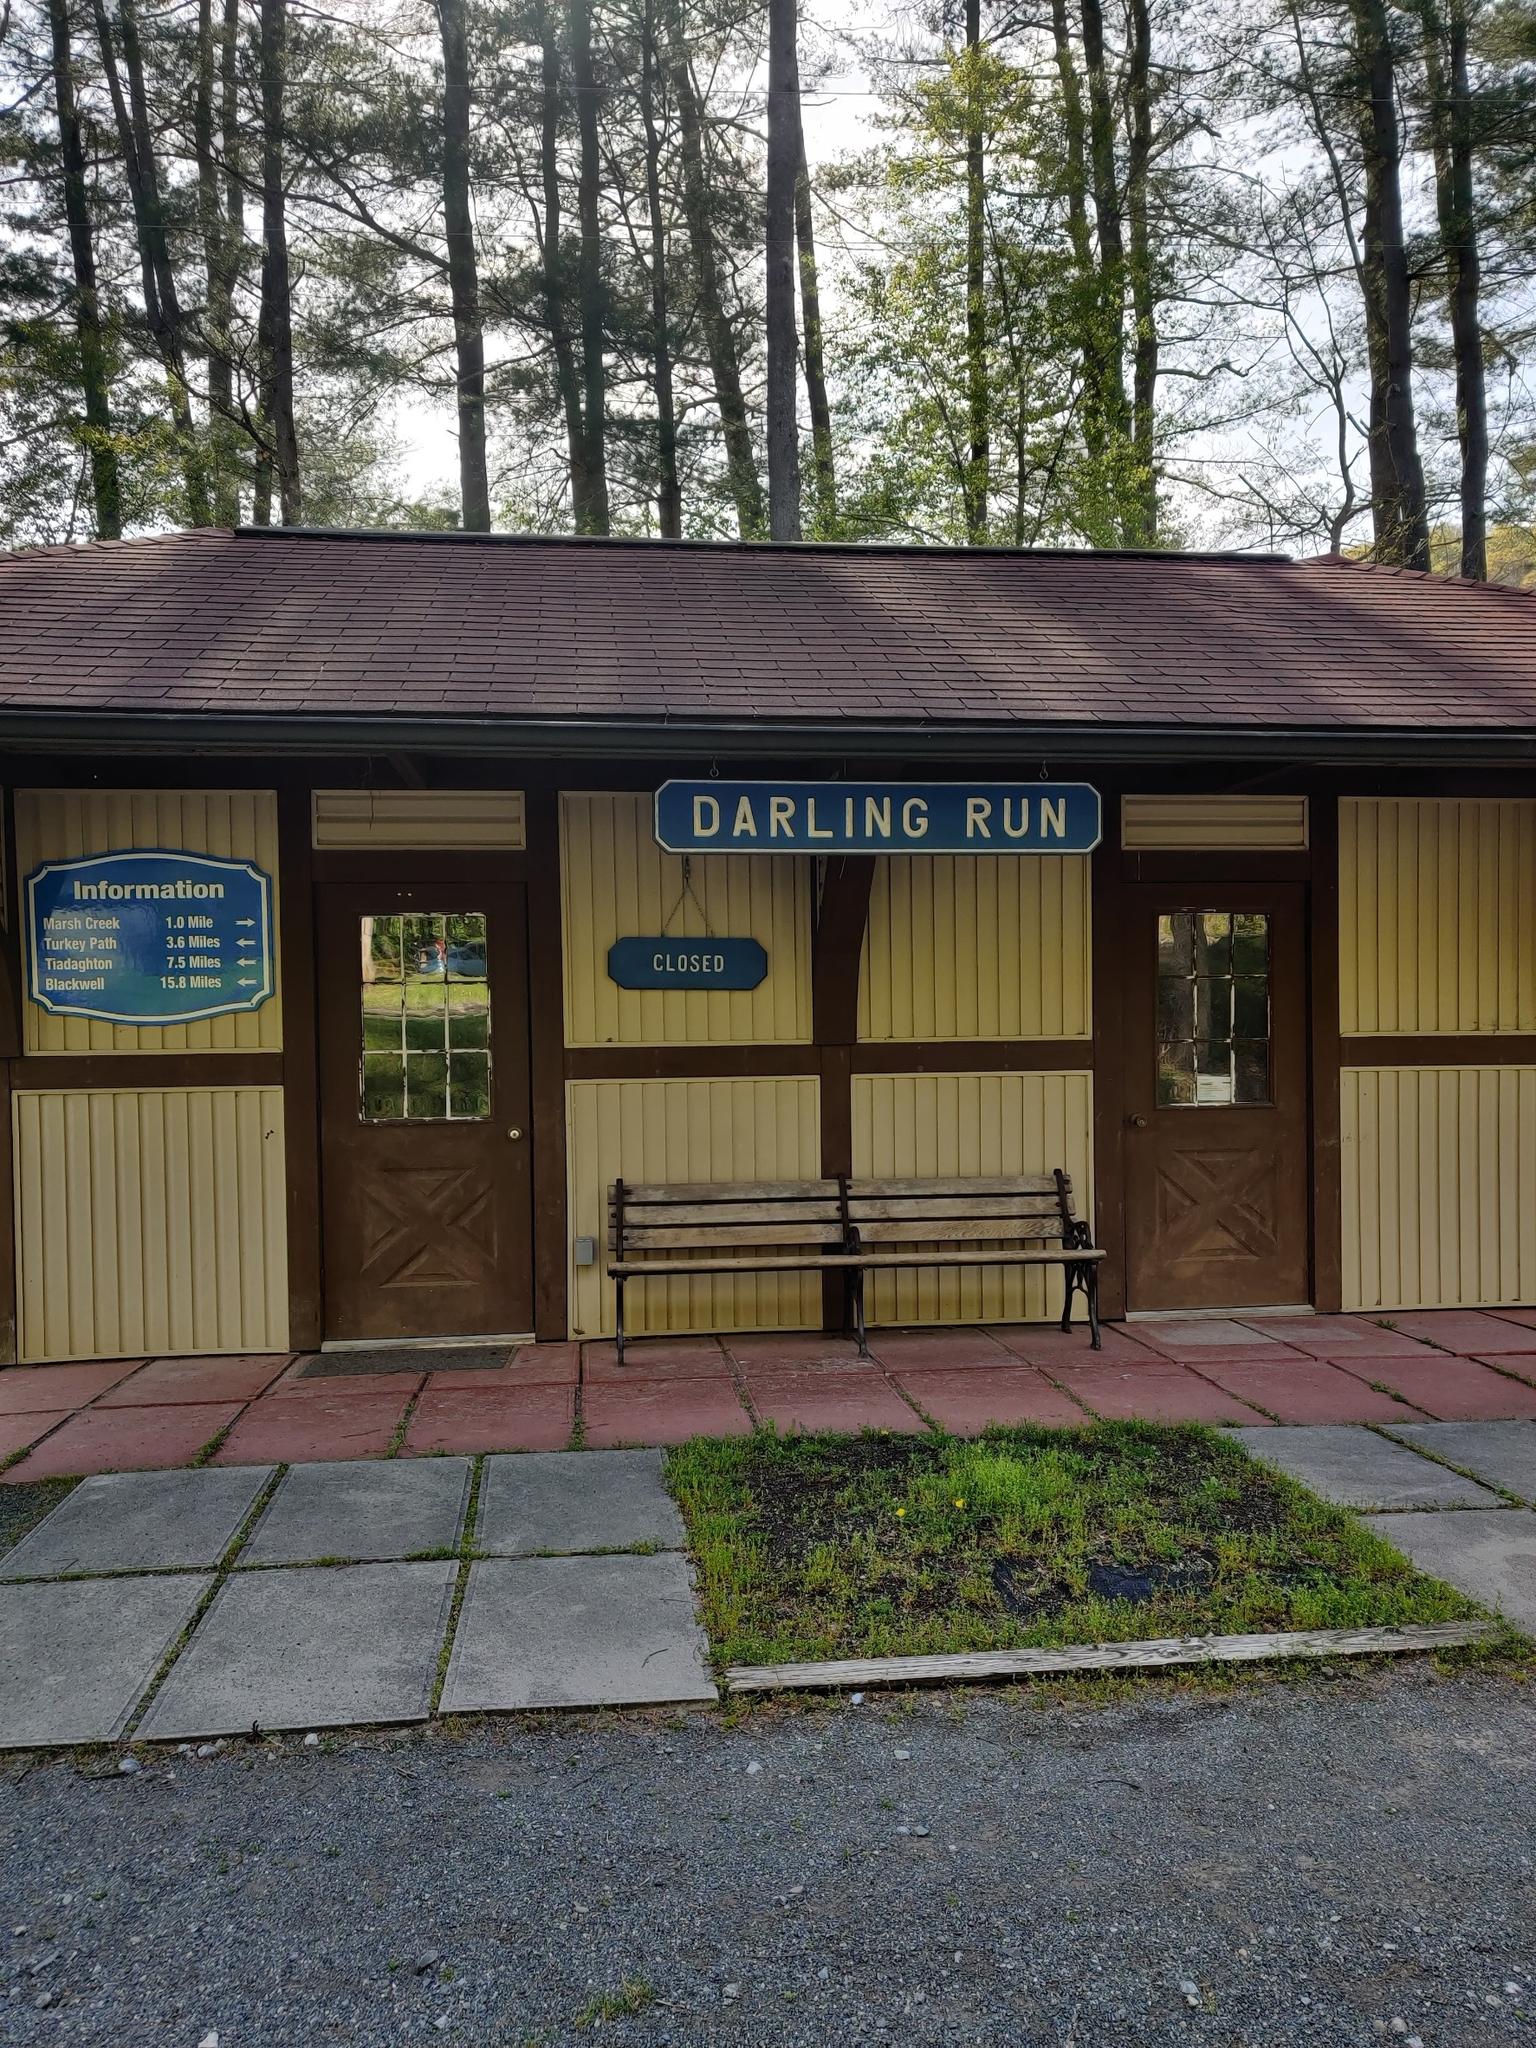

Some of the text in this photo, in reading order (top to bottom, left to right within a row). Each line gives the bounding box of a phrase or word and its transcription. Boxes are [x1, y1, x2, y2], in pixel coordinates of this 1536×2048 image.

[693, 795, 1067, 839] DARLING RUN
[73, 880, 225, 900] Information
[43, 915, 214, 930] Marsh Creek 1.0 Mile
[44, 935, 221, 952] Turkey Path 3.6 Miles
[45, 955, 221, 972] Tiadaghton 7.5 Miles
[653, 953, 725, 973] CLOSED
[45, 975, 222, 990] Blackwell 15.8 Miles
